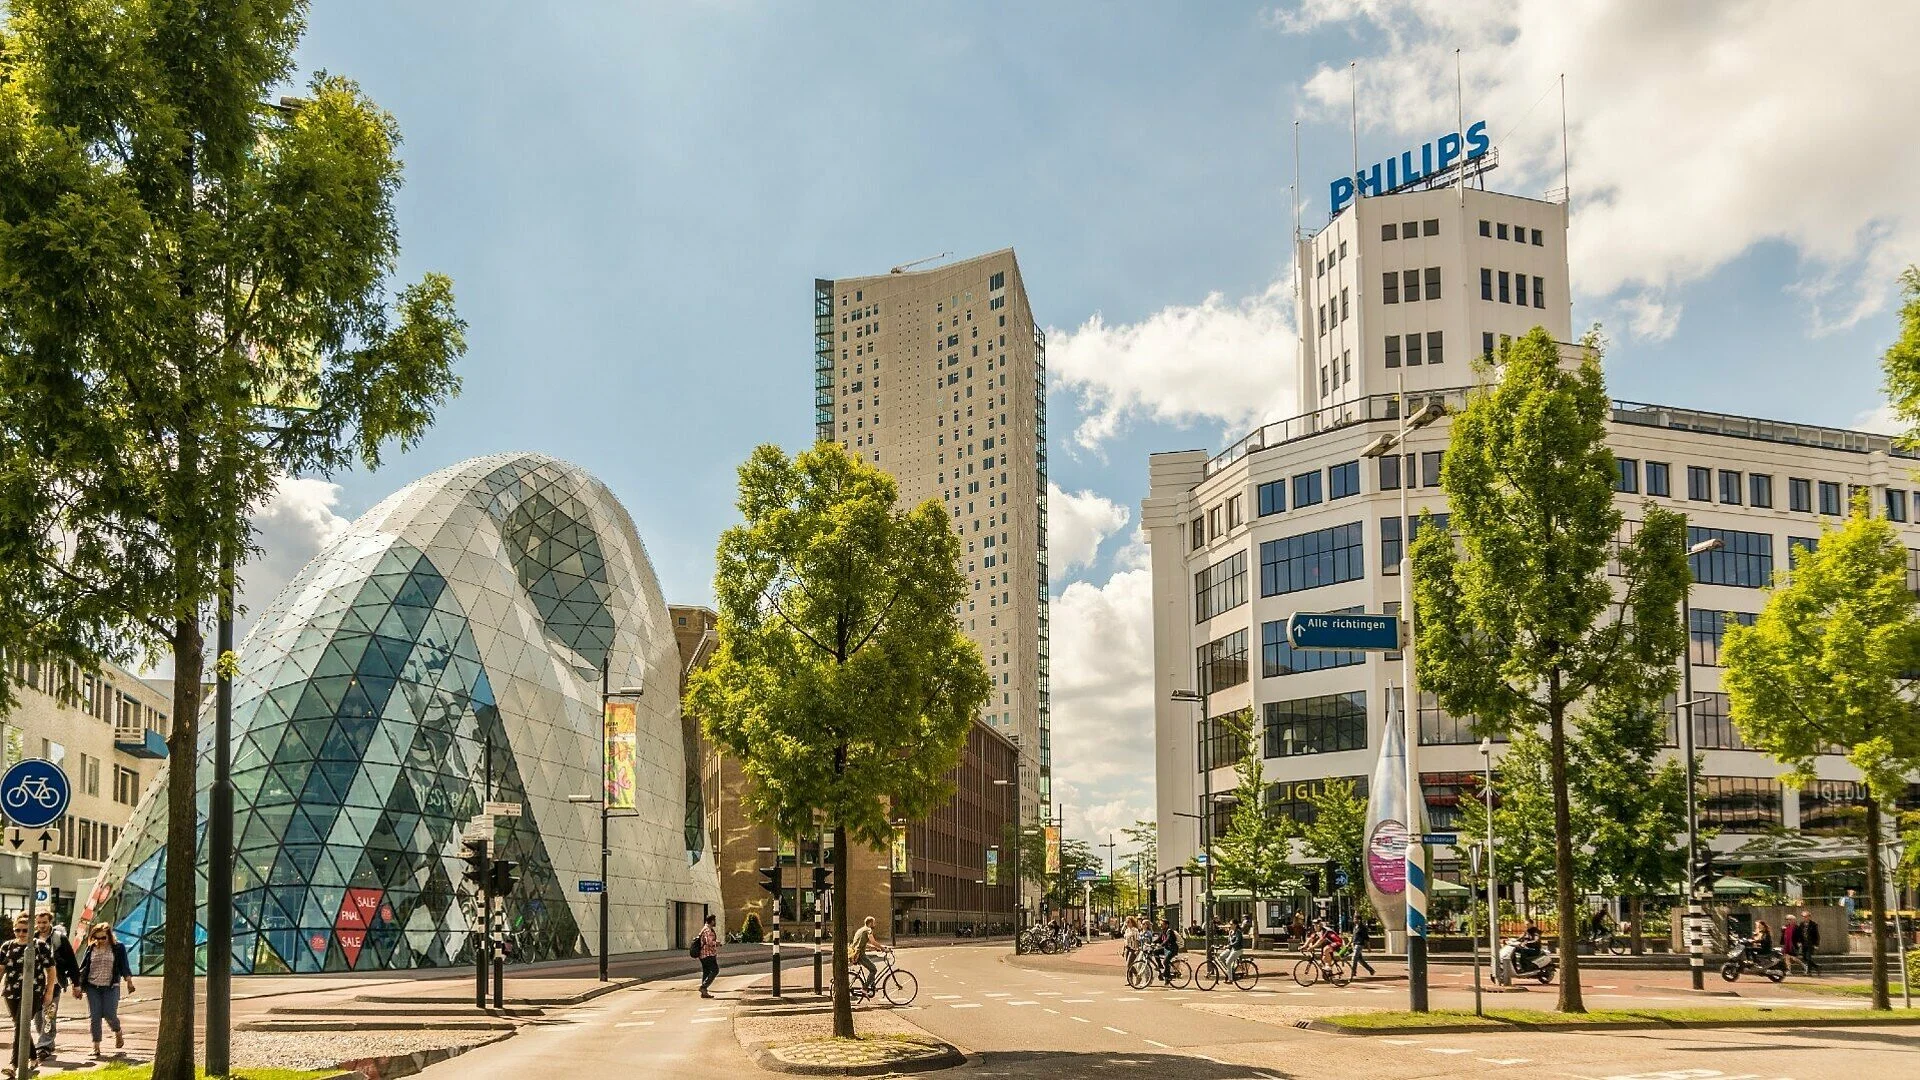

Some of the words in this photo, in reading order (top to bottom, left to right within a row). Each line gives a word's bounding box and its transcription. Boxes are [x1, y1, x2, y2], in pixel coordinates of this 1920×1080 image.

[1330, 120, 1490, 213] PHILIPS
[1307, 618, 1328, 628] Alle
[1332, 619, 1386, 631] richtingen
[357, 897, 376, 907] SALE
[341, 936, 361, 948] SALE
